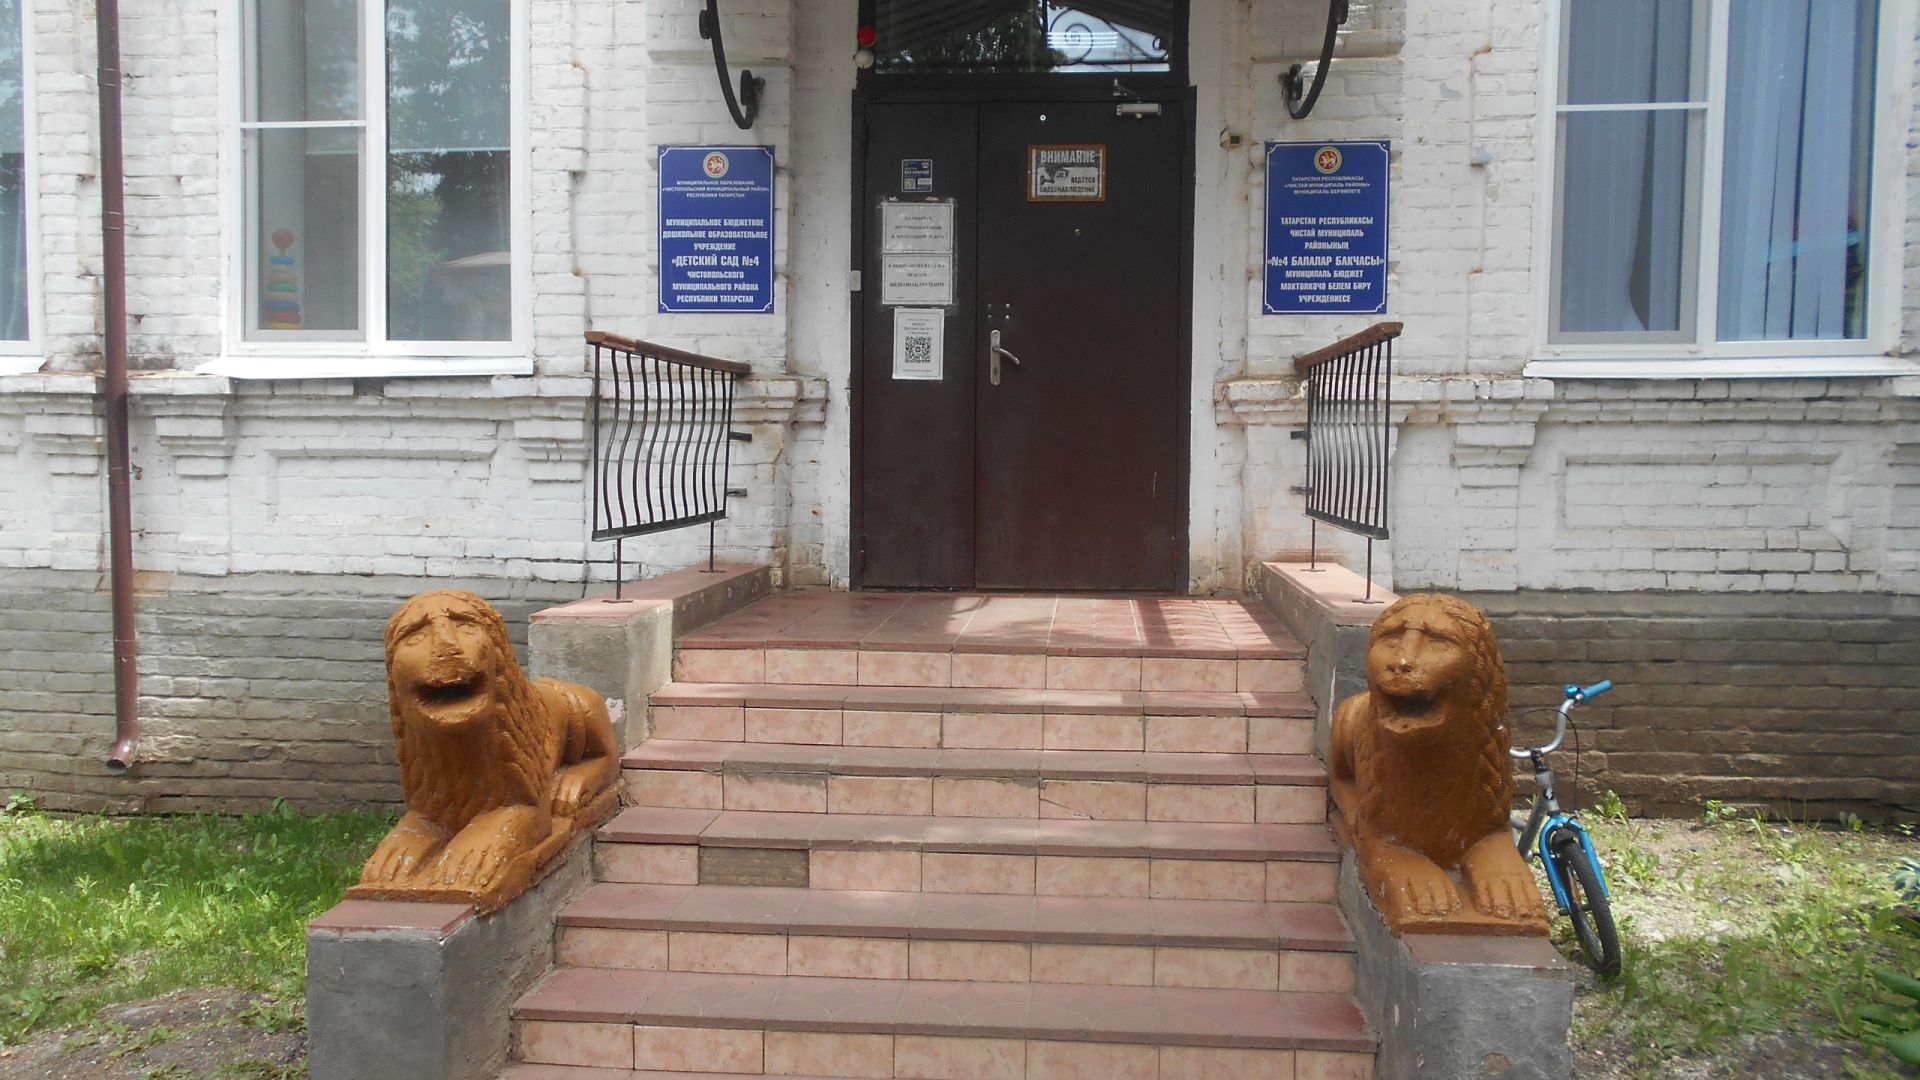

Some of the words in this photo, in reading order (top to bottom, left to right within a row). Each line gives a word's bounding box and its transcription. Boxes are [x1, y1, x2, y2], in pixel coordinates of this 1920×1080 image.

[1040, 150, 1095, 163] ВНИМАНИЕ
[666, 218, 722, 228] МУНИЦИПАЛЬНОЕ
[723, 218, 763, 227] БЮДЖЕТНОЕ
[1281, 217, 1317, 225] ТАТАРСТАН
[1319, 217, 1373, 225] РЕСПУБЛИКАСЫ
[662, 230, 706, 239] ДОШКОЛЬНОЕ
[708, 230, 768, 239] ОБРАЗОВАТЕЛЬНОЕ
[1290, 228, 1316, 237] ЧИСТАЙ
[1317, 229, 1364, 238] МУНИЦИПАЛЬ
[693, 243, 736, 251] УЧРЕЖДЕНИЕ
[671, 254, 717, 267] «ДЕТСКИЙ
[720, 255, 740, 267] САД
[742, 255, 759, 266] №4
[1291, 256, 1333, 266] БАЛАЛАР
[1335, 256, 1384, 266] БАКЧАСЫ»
[1285, 270, 1332, 279] МУНИЦИПАЛЬ
[1333, 270, 1364, 278] БЮДЖЕТ
[672, 283, 732, 292] МУНИЦИПАЛЬНОГО
[733, 282, 759, 291] РАЙОНА
[1328, 282, 1351, 290] БЕЛЕМ
[676, 295, 718, 303] РЕСПУБЛИКИ
[719, 295, 754, 303] ТАТАРСТАН
[1298, 295, 1351, 303] УЧРЕЖДЕНИЕСЕ
